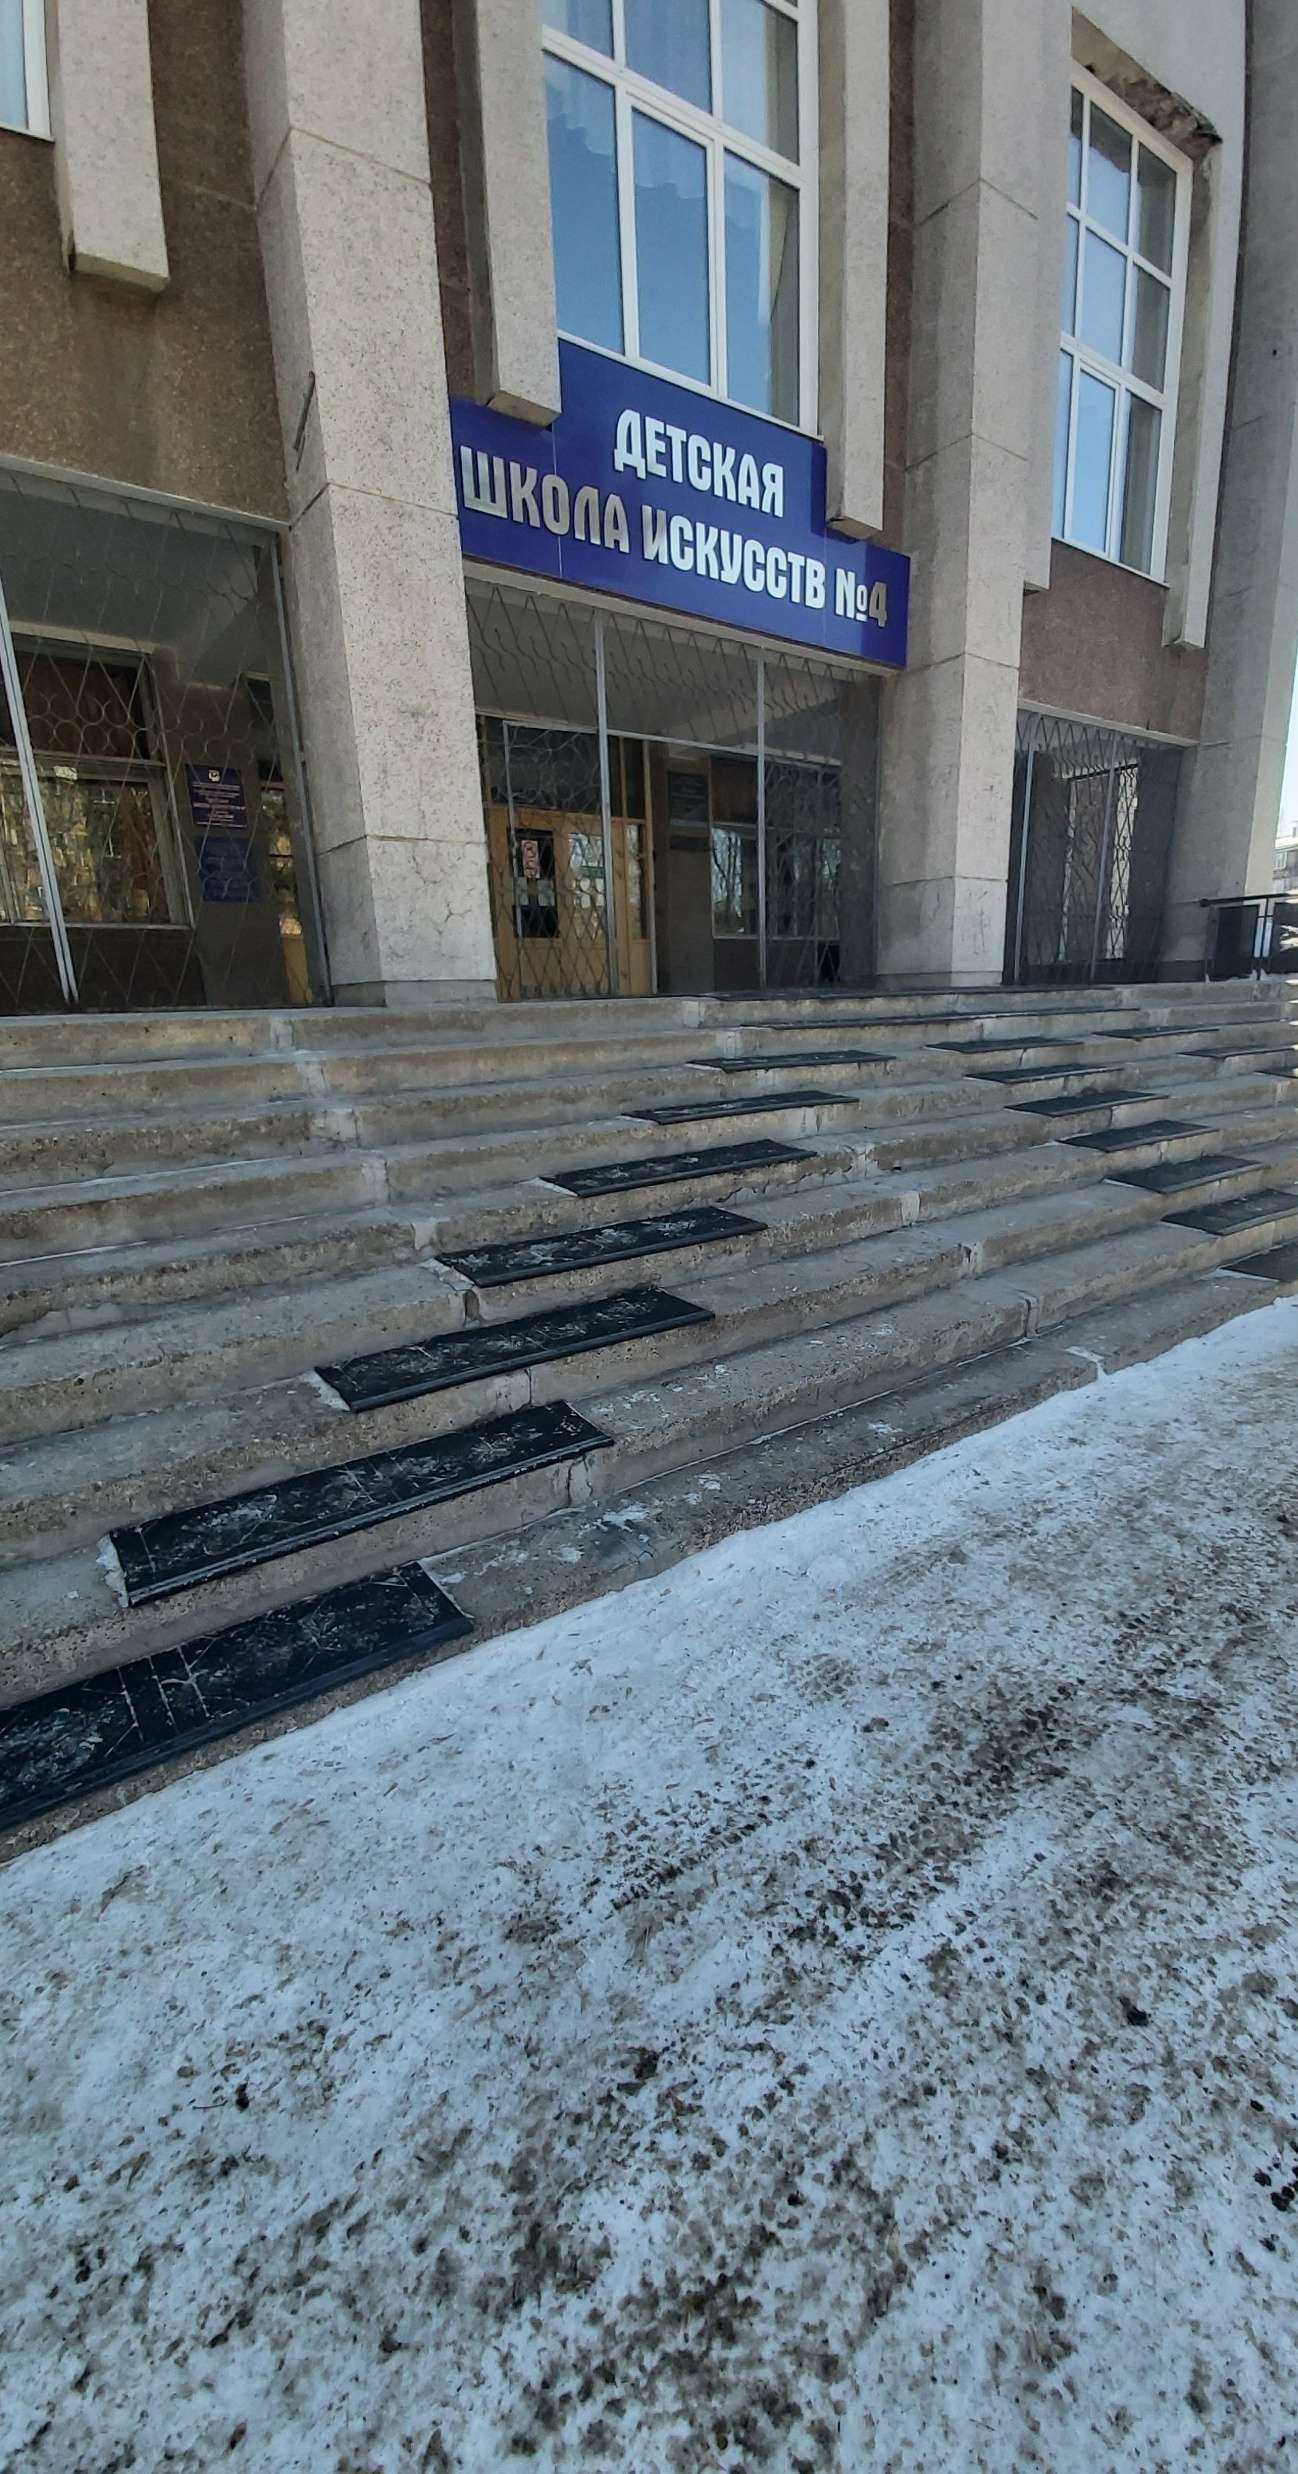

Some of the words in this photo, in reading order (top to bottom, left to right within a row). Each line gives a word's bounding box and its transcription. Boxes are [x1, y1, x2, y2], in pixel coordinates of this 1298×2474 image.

[460, 445, 630, 554] ШКОЛА
[642, 504, 826, 609] ИСКУССТВ
[835, 567, 887, 627] №4
[614, 409, 784, 518] ДЕТСКАЯ
